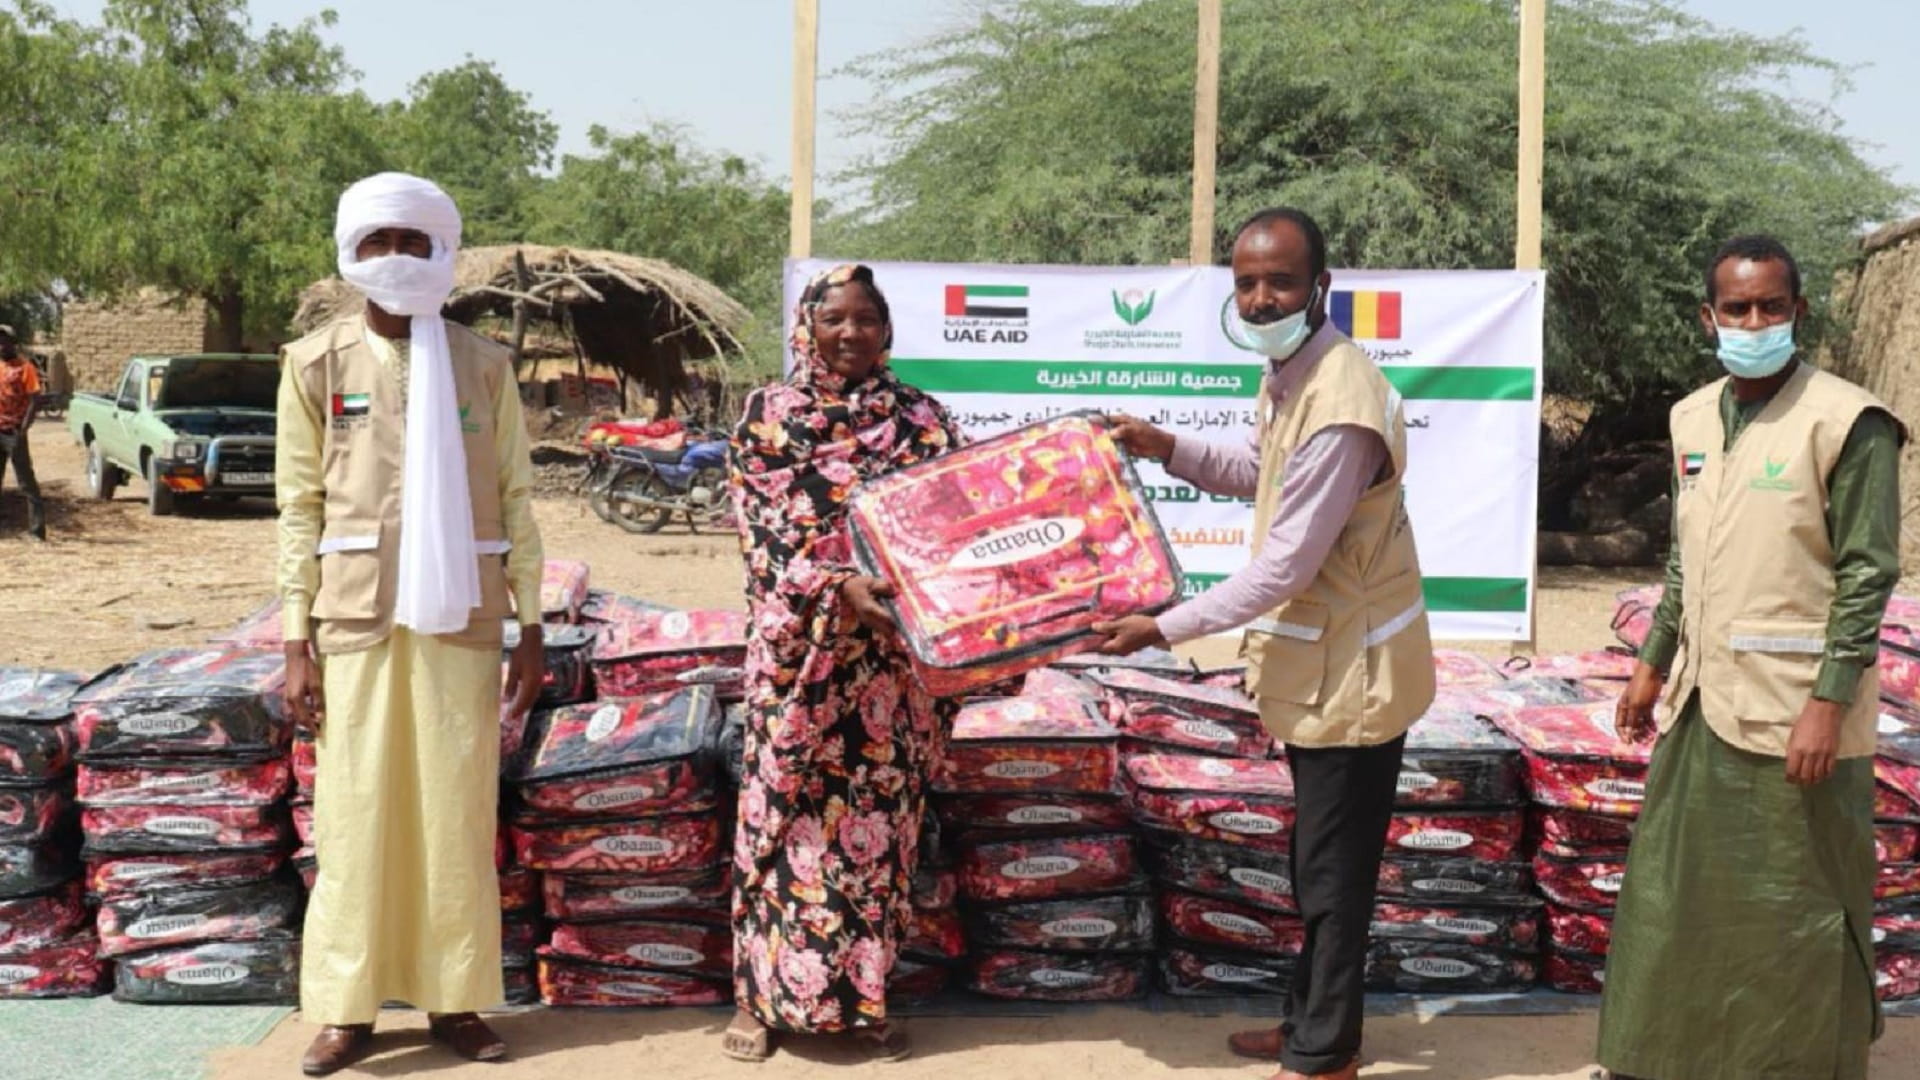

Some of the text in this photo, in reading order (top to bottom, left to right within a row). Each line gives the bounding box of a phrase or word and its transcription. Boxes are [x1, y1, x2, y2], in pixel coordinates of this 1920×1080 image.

[944, 329, 1028, 343] UAE AID
[1036, 368, 1242, 391] جمعية الشارقة الخيرية
[970, 521, 1065, 559] Obama
[1169, 526, 1244, 549] التنفيذ
[606, 837, 663, 852] Obama
